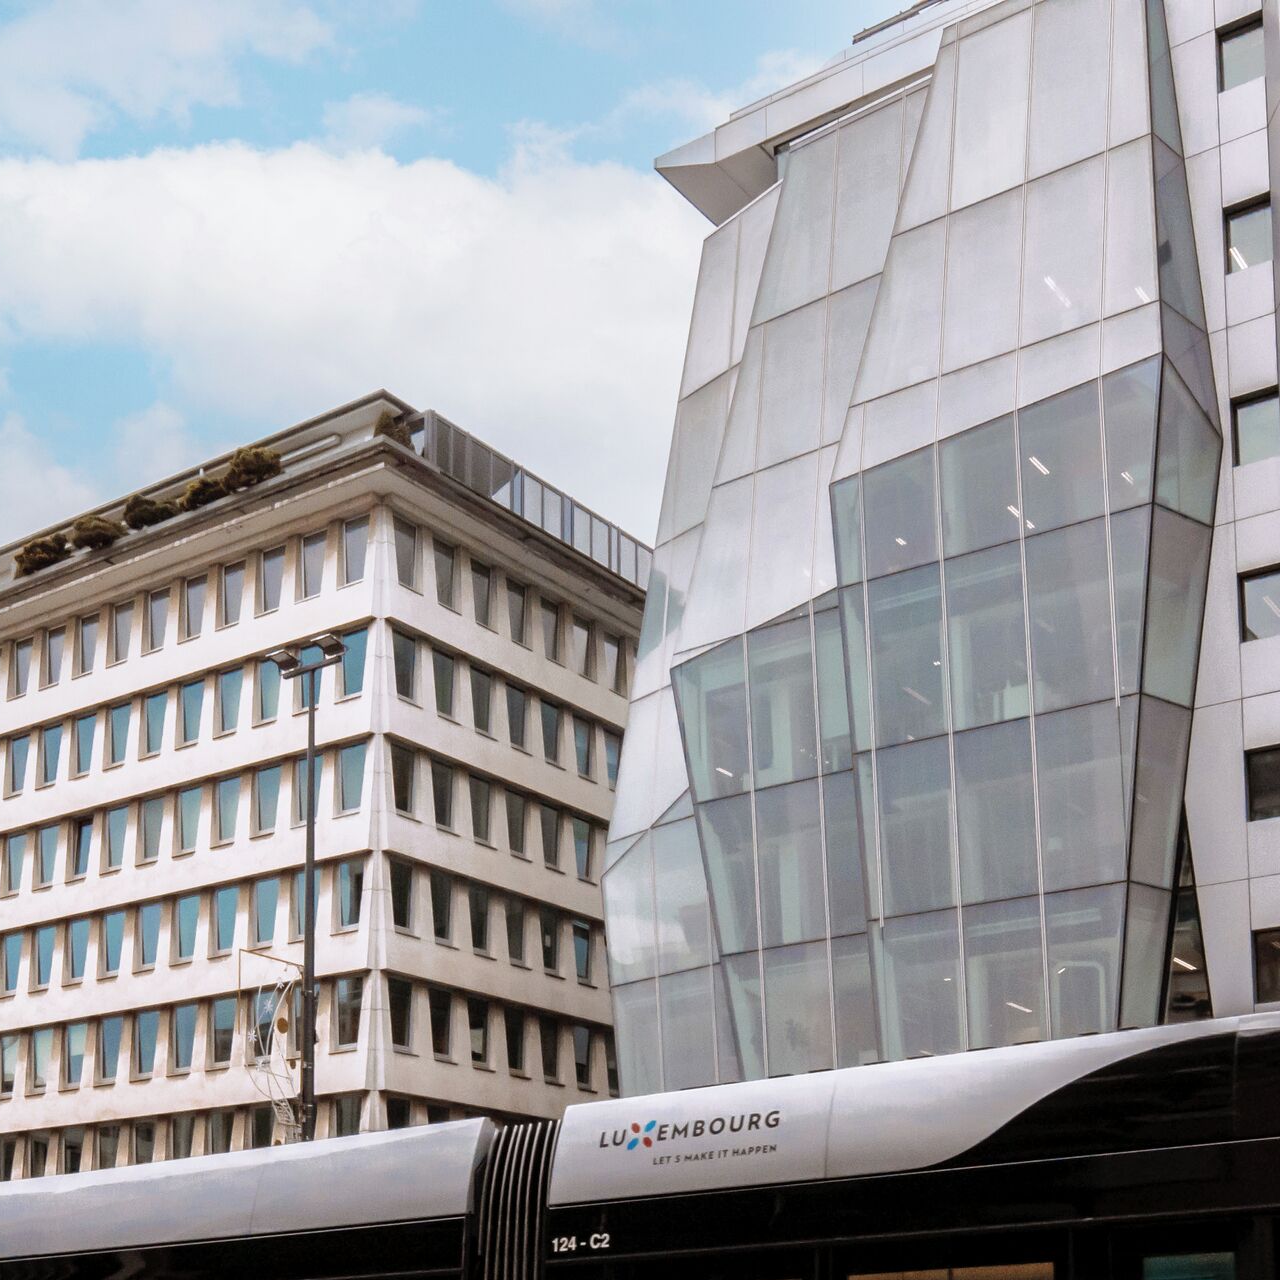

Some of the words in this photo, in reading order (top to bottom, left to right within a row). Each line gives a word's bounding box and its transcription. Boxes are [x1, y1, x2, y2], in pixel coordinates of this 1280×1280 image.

[599, 1110, 781, 1151] LUXEMBOURG
[683, 1150, 714, 1161] MAKE
[717, 1149, 729, 1159] IT
[731, 1144, 777, 1157] HAPPEN
[551, 1235, 577, 1252] 124
[589, 1232, 610, 1249] C2
